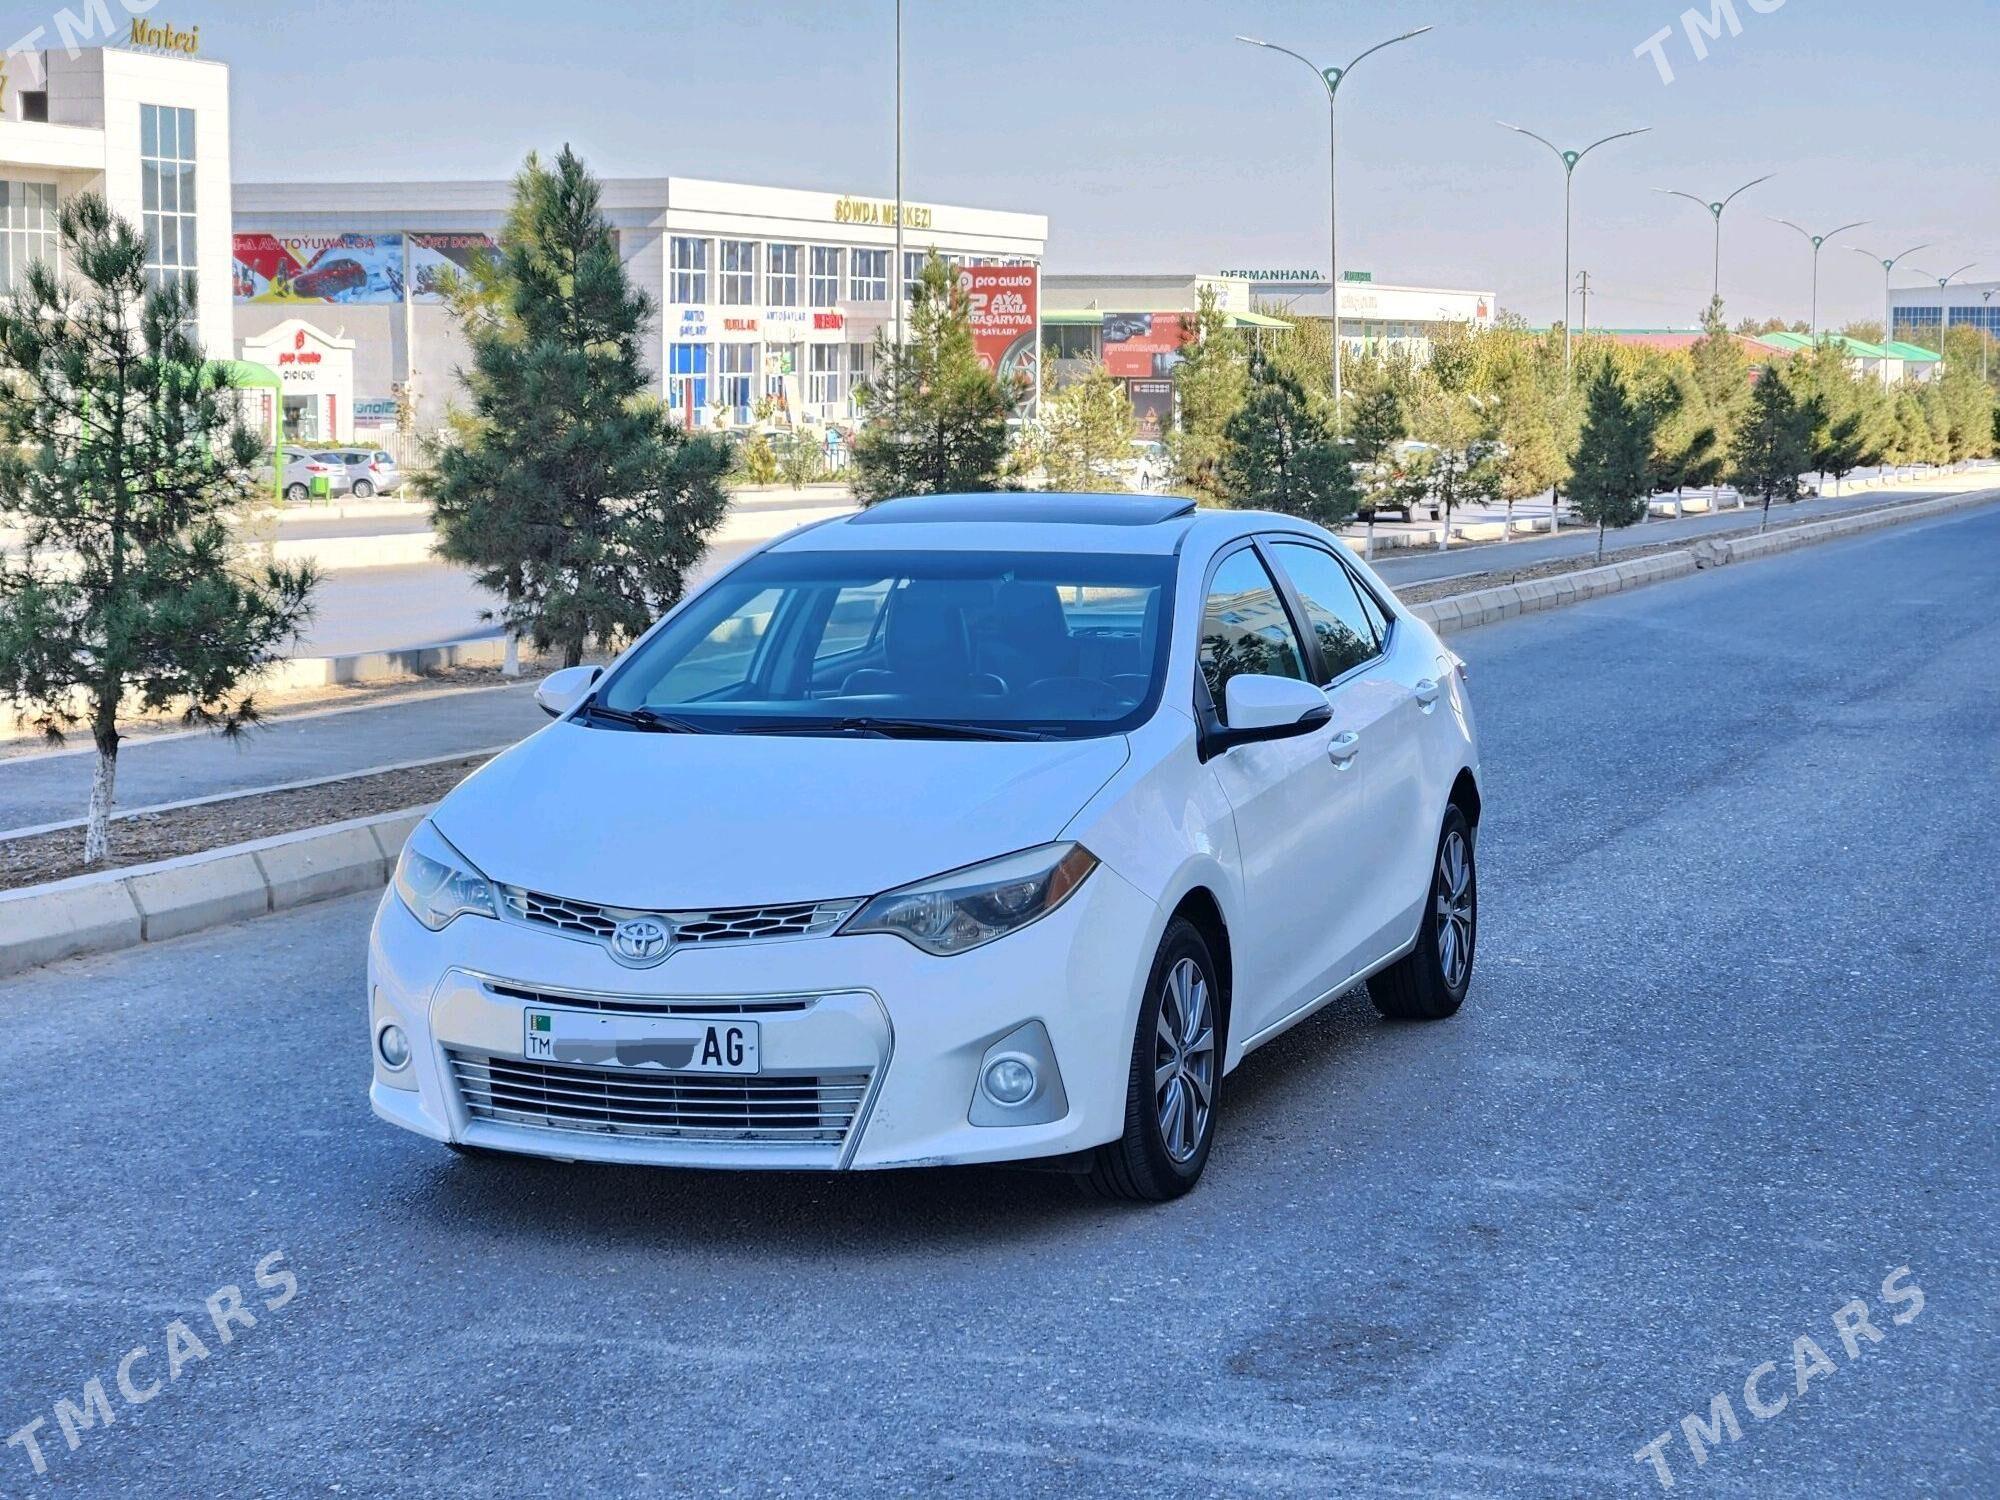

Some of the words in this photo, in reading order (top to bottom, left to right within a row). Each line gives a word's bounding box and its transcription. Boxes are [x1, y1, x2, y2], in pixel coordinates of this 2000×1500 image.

[1219, 269, 1320, 281] DERMANHANA
[975, 276, 997, 288] pro
[701, 1026, 744, 1067] AG
